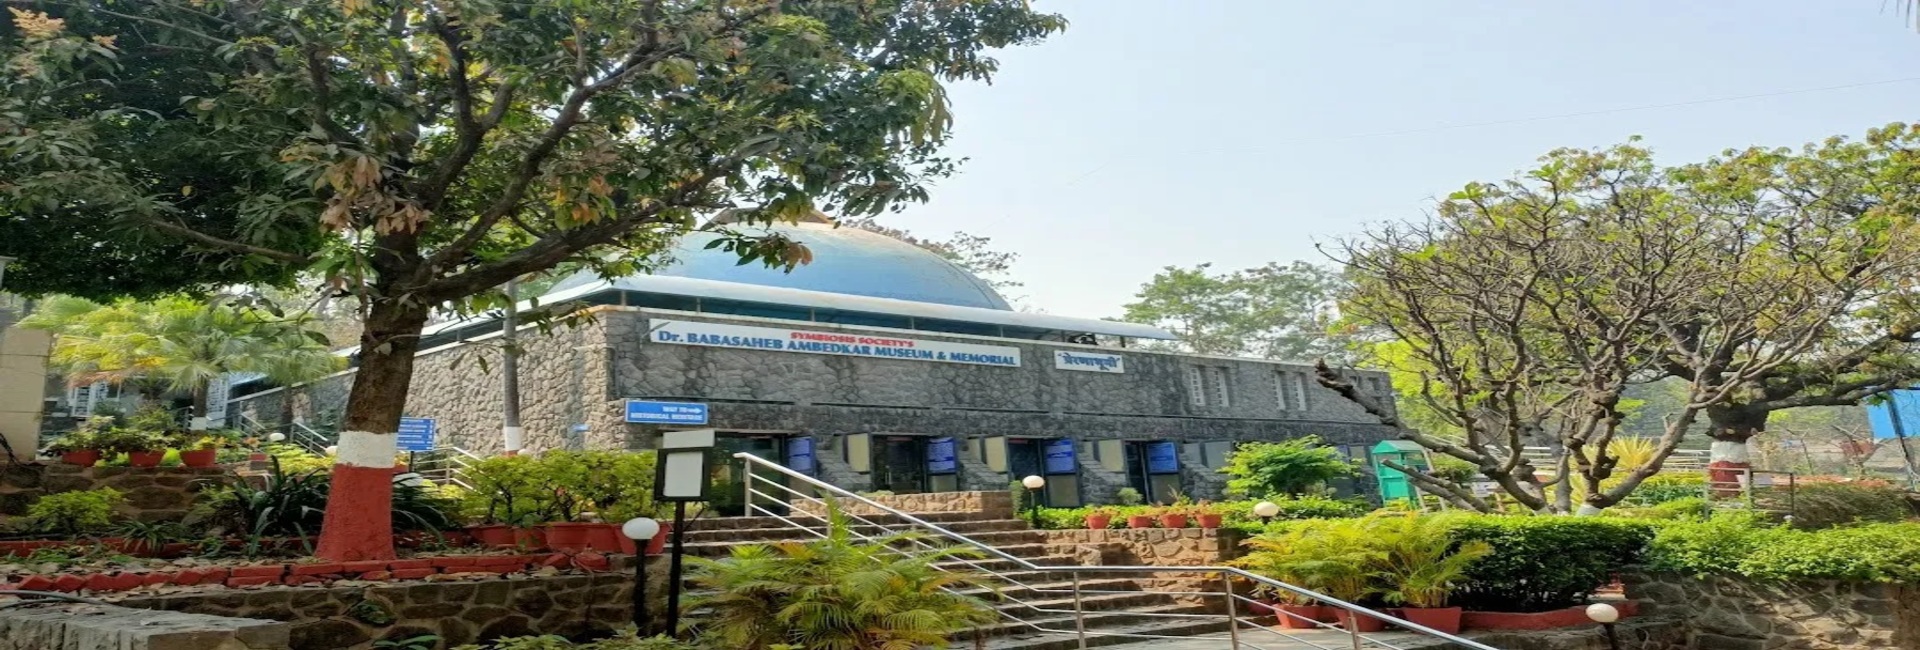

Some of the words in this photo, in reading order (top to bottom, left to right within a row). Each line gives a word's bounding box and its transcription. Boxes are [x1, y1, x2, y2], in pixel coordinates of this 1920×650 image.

[658, 330, 683, 342] Dr.
[687, 332, 783, 349] BABASAHEB
[787, 340, 871, 355] AMBEDKAR
[874, 346, 934, 360] MUSEUM
[936, 351, 947, 360] &
[950, 352, 1017, 365] MEMORIAL
[790, 332, 856, 343] SYMBIOSIS
[858, 336, 914, 347] SOCIETY'S
